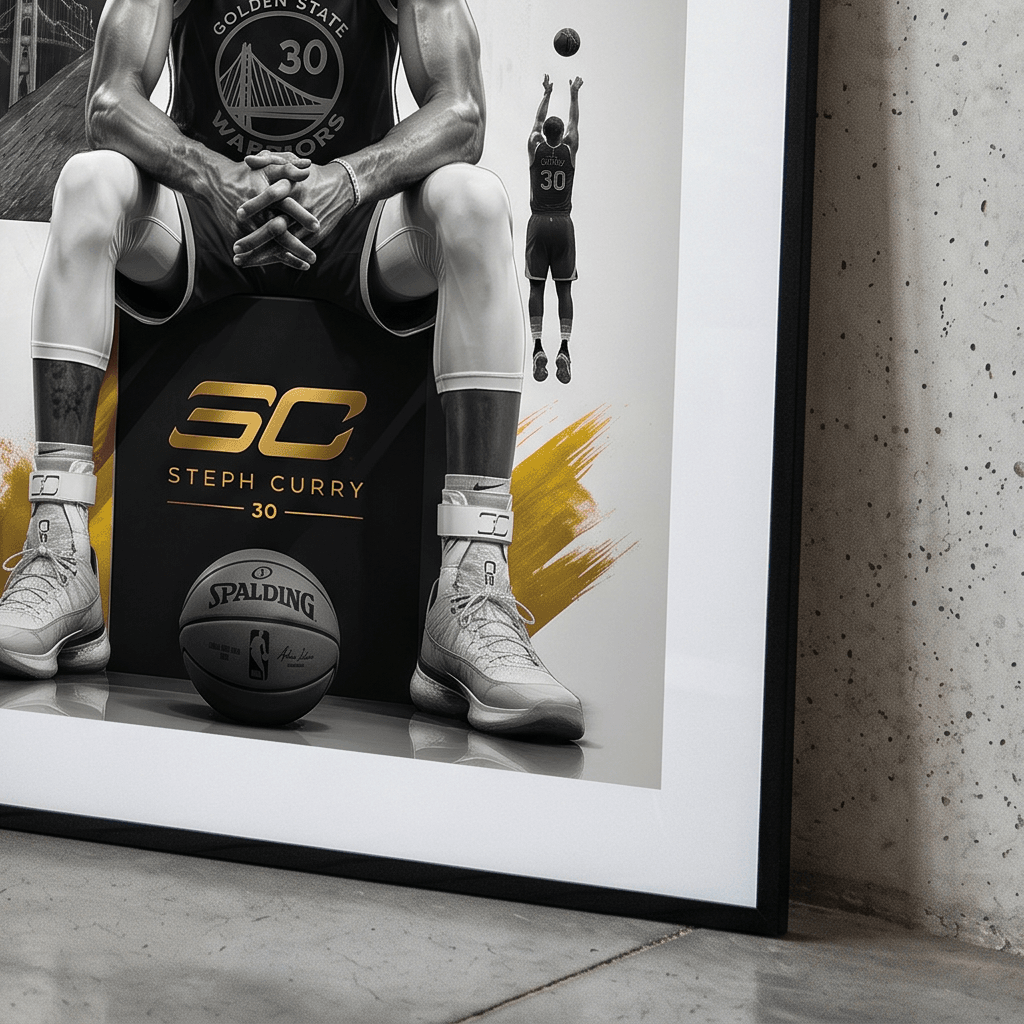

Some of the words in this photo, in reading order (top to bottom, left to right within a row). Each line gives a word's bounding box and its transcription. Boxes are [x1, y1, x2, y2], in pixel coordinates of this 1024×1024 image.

[278, 39, 328, 75] 30
[540, 169, 566, 191] 30
[168, 467, 254, 490] STEPH
[270, 475, 364, 499] CURRY
[251, 502, 278, 520] 30
[208, 582, 318, 622] SPALDING
